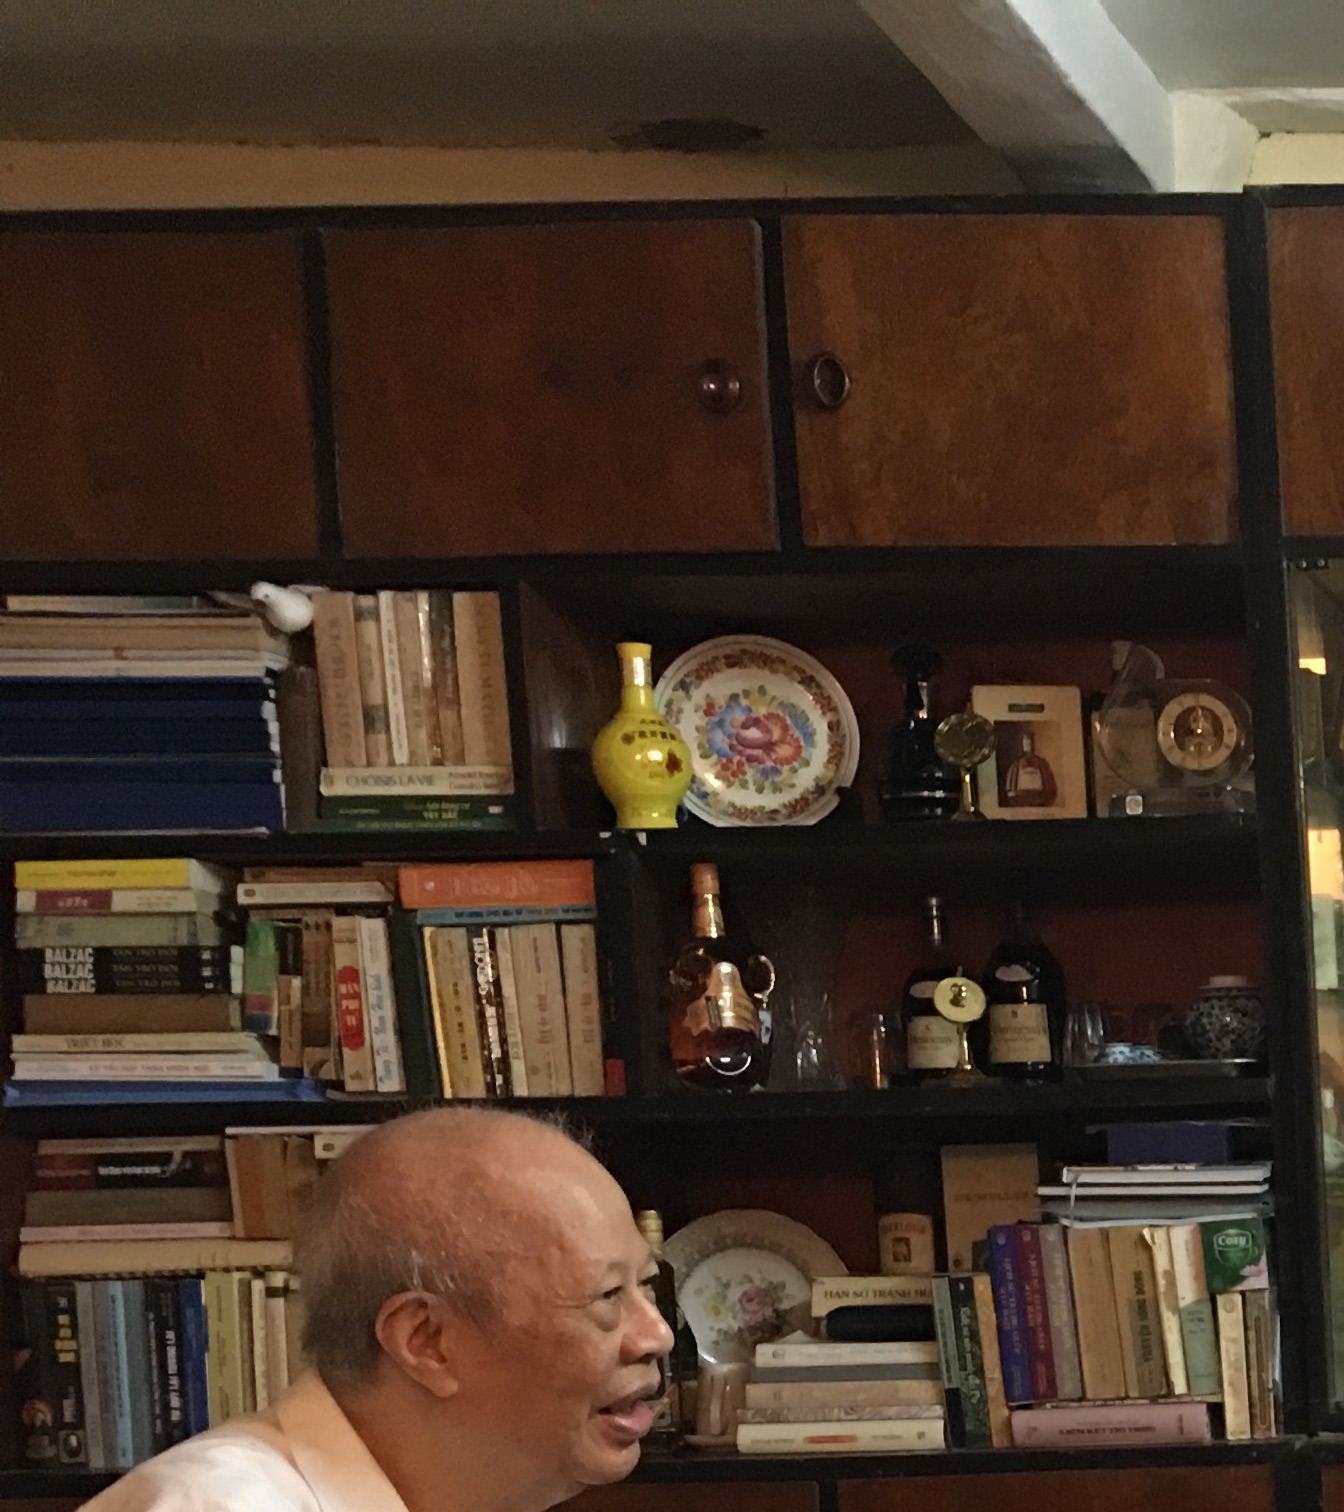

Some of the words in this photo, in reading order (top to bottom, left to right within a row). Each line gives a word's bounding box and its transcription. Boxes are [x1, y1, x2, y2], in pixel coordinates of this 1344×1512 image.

[46, 948, 94, 963] BALZAC
[45, 963, 94, 979] BALZAC
[46, 979, 96, 993] BALZAC
[1218, 1235, 1247, 1248] Cozy
